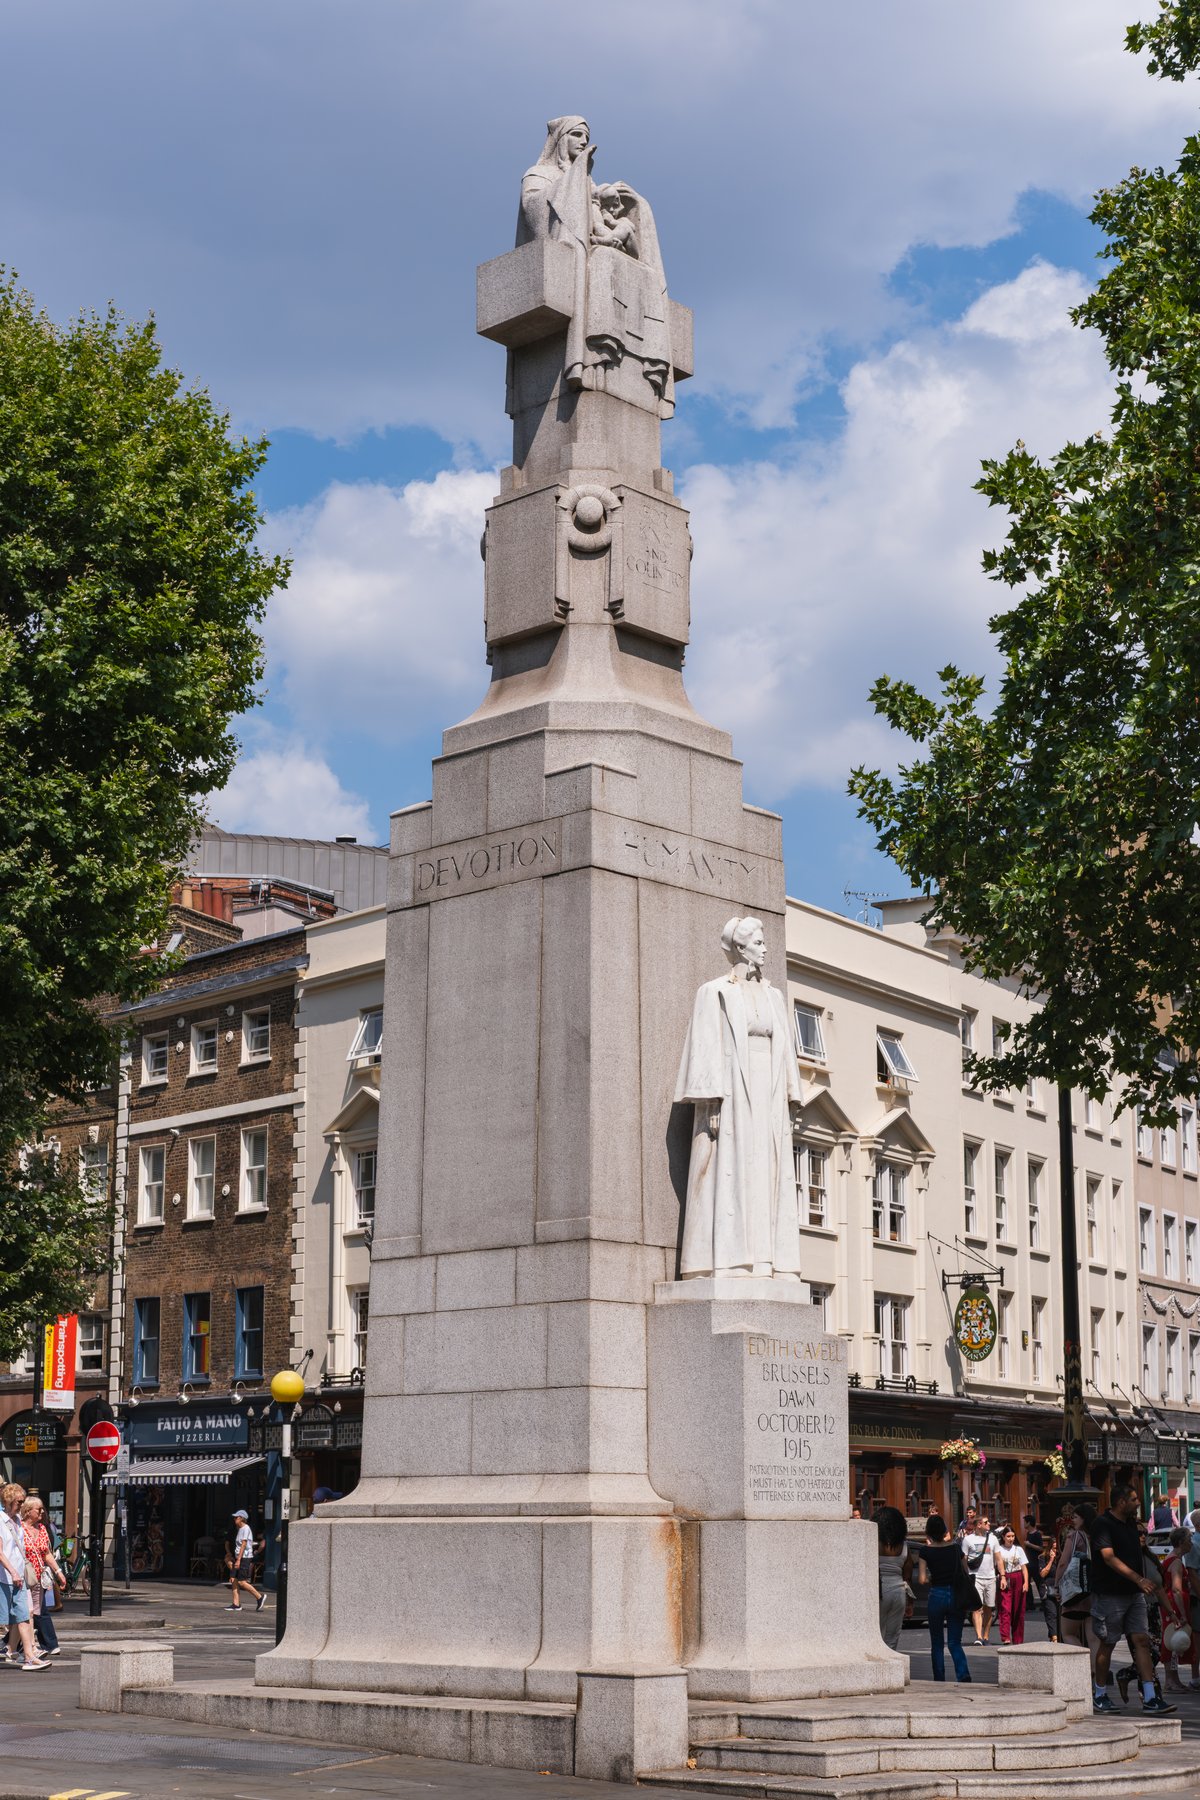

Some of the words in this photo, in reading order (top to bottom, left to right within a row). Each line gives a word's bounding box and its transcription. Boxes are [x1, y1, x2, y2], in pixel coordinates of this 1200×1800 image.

[418, 831, 557, 891] DEVOTION
[55, 1318, 68, 1389] Trainspotting
[749, 1337, 789, 1358] EDITH
[794, 1341, 842, 1362] CAVELL
[961, 1344, 991, 1360] CHANDOS
[762, 1363, 831, 1385] BRUSSELS
[779, 1389, 815, 1408] DAWN
[157, 1416, 191, 1431] FATTO
[194, 1415, 203, 1430] A
[206, 1413, 242, 1429] MANO
[758, 1413, 822, 1433] OCTOBER
[824, 1414, 835, 1434] 12
[15, 1428, 57, 1436] COFEE
[175, 1433, 222, 1442] PIZZERIA
[864, 1425, 881, 1439] BAR
[891, 1427, 922, 1442] DINING
[989, 1432, 1005, 1447] THE
[1005, 1433, 1041, 1450] CHANDOS
[784, 1438, 812, 1461] 1915
[749, 1464, 789, 1476] PATRIOTISM
[791, 1465, 797, 1476] IS
[799, 1466, 813, 1476] NOT
[814, 1466, 845, 1477] ENOUGH
[753, 1478, 772, 1488] MUST
[774, 1478, 793, 1488] HAVE
[795, 1479, 806, 1489] NO
[807, 1479, 835, 1489] HATRED
[836, 1479, 846, 1490] OR
[753, 1490, 795, 1501] BITTERNESS
[797, 1491, 812, 1501] FOR
[812, 1491, 841, 1502] ANYONE
